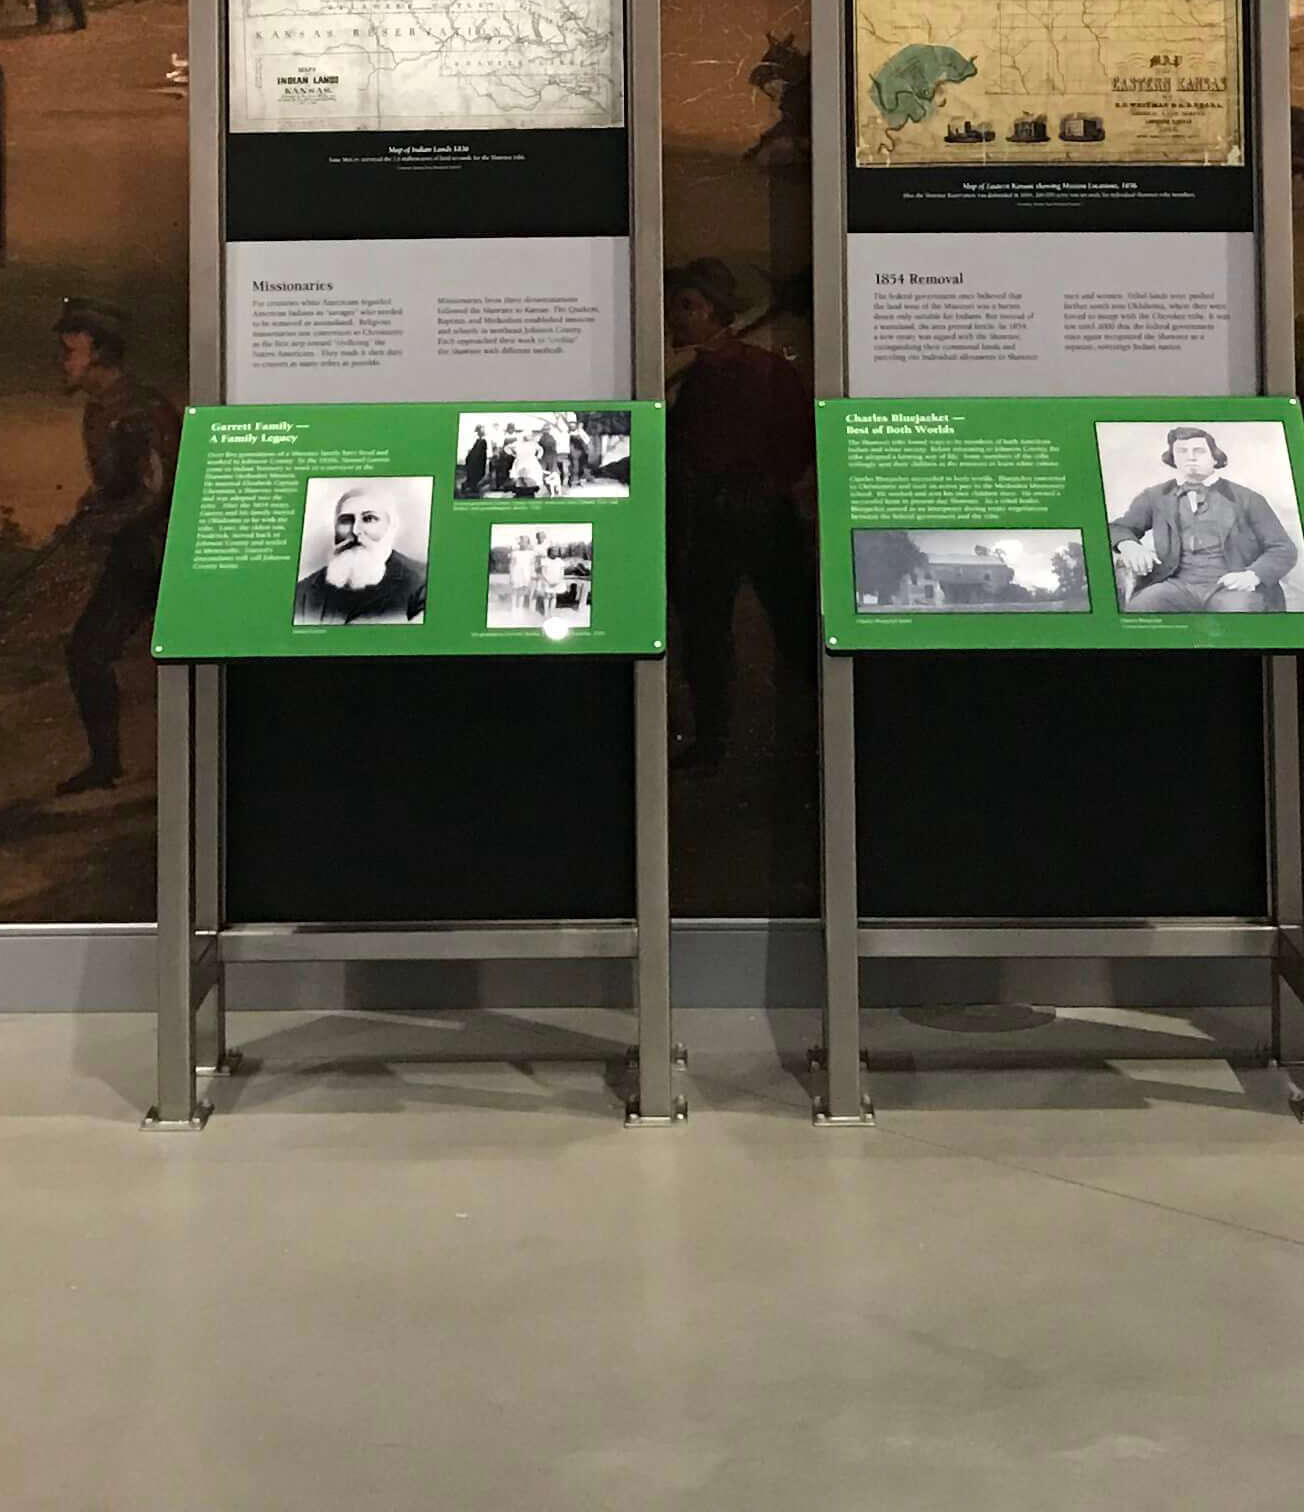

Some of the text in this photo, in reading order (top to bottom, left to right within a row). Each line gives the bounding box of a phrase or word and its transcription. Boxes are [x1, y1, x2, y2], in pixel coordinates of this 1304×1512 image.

[876, 272, 964, 285] 1854 Removal
[253, 280, 333, 292] Missionaries
[846, 414, 888, 423] Charles
[891, 413, 950, 425] Bluejacket
[211, 423, 251, 432] Garrett
[255, 421, 294, 432] Family
[846, 424, 954, 434] Best of Both Worlds
[209, 433, 298, 444] A Family Legacy
